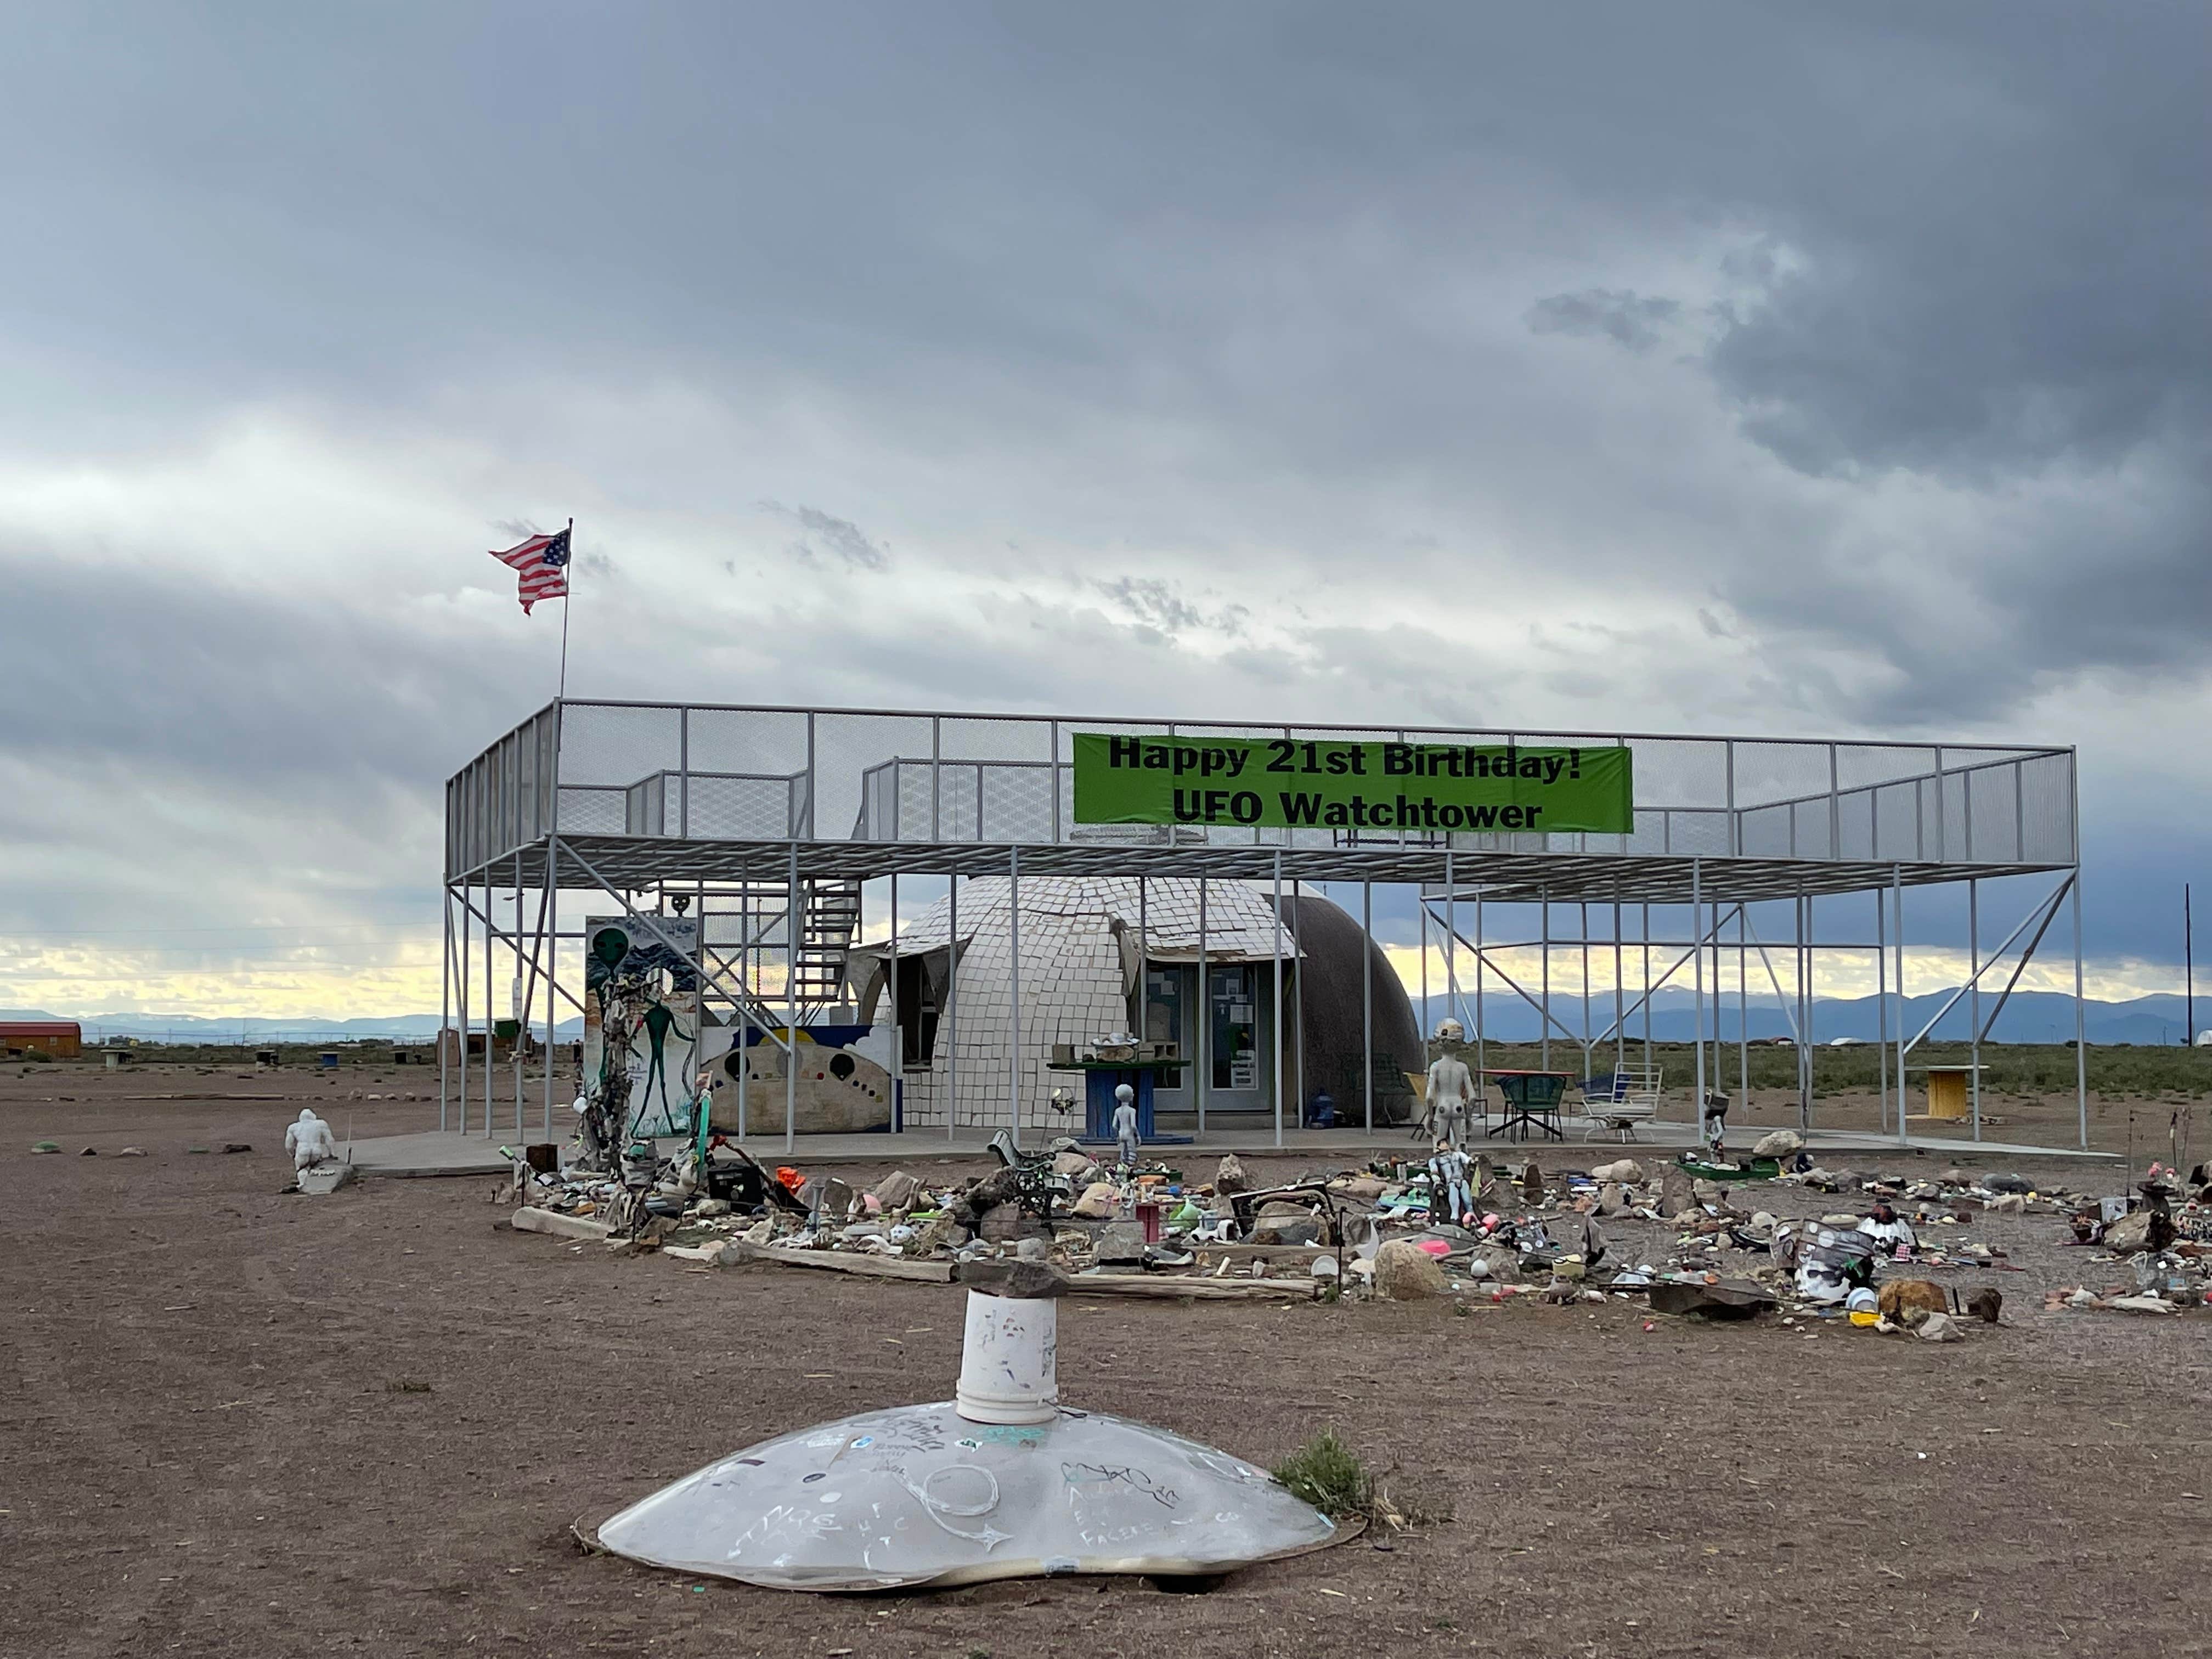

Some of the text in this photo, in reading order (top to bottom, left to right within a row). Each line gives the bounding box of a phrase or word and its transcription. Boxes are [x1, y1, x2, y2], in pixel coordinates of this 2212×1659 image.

[1110, 736, 1581, 785] Happy 21st Birthday!
[1173, 788, 1543, 829] UFO Watchtower
